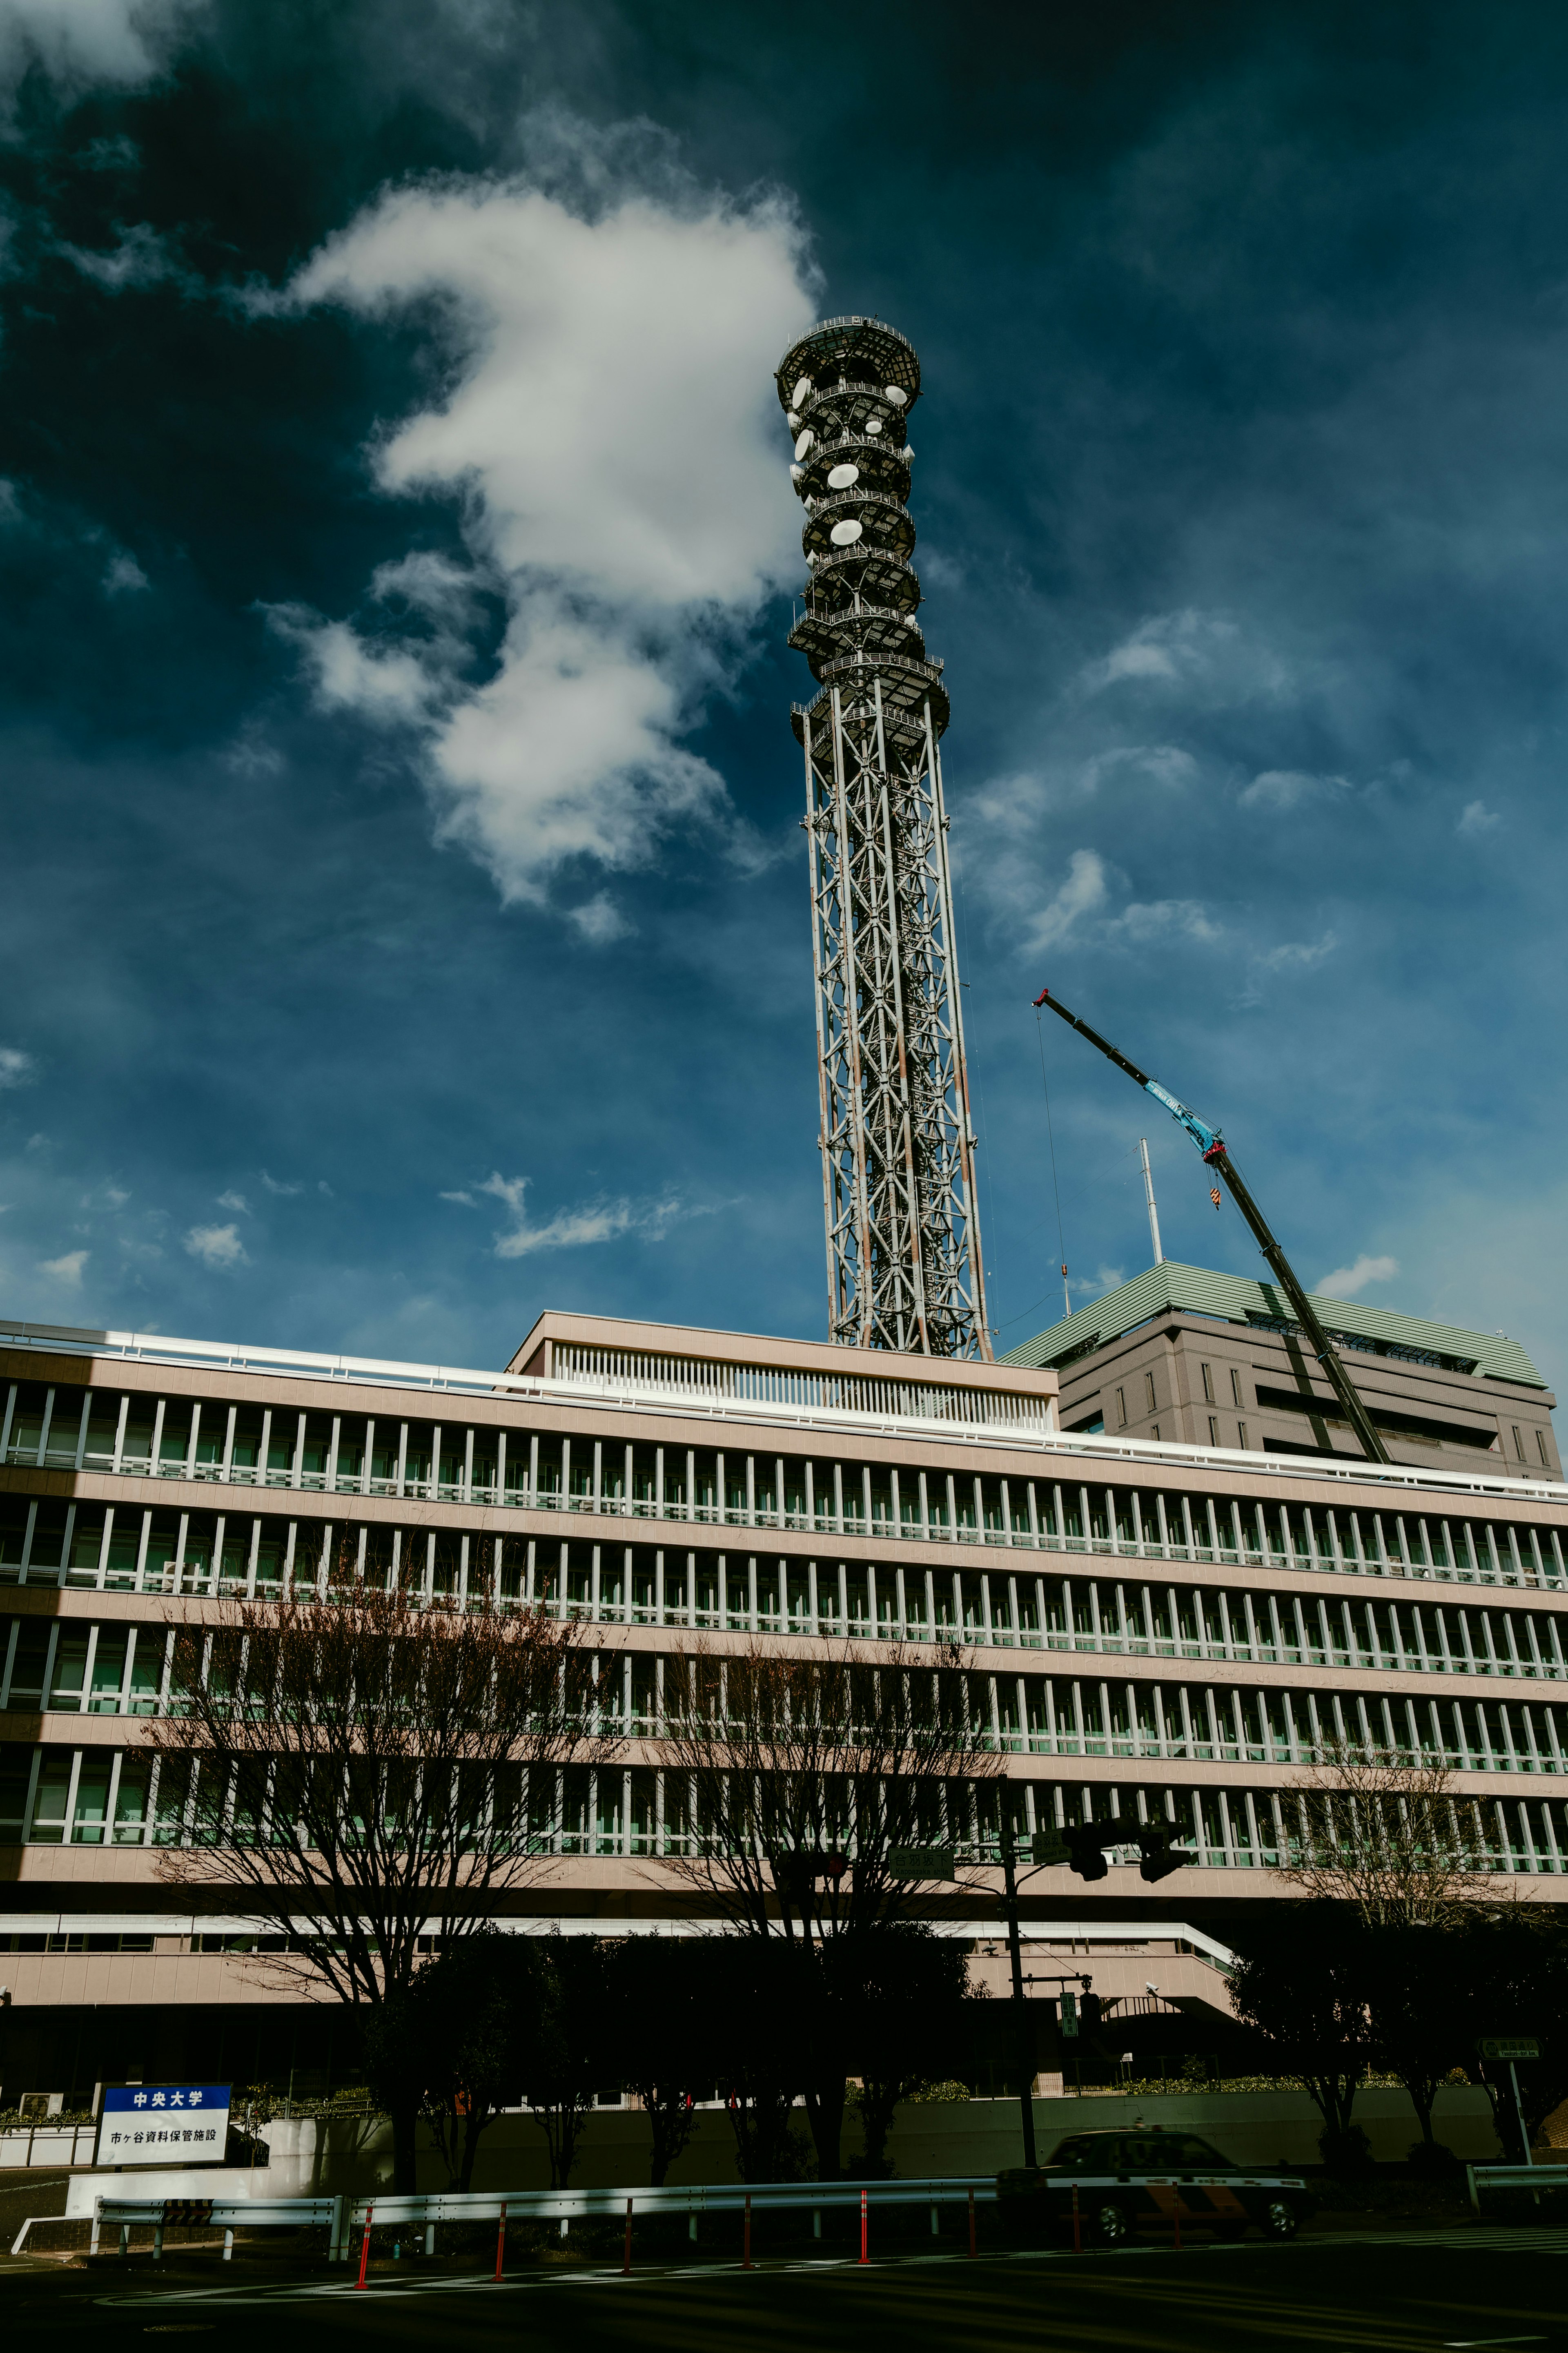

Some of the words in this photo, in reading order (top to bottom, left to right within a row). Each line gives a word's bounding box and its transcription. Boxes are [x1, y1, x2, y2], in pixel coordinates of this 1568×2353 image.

[1152, 1087, 1168, 1101] HUMAN
[1036, 1833, 1062, 1851] 合羽坂
[895, 1854, 948, 1867] 合羽坂下
[896, 1868, 931, 1876] Kappazaka
[1486, 2045, 1498, 2053] 302
[134, 2091, 203, 2108] 中央大学
